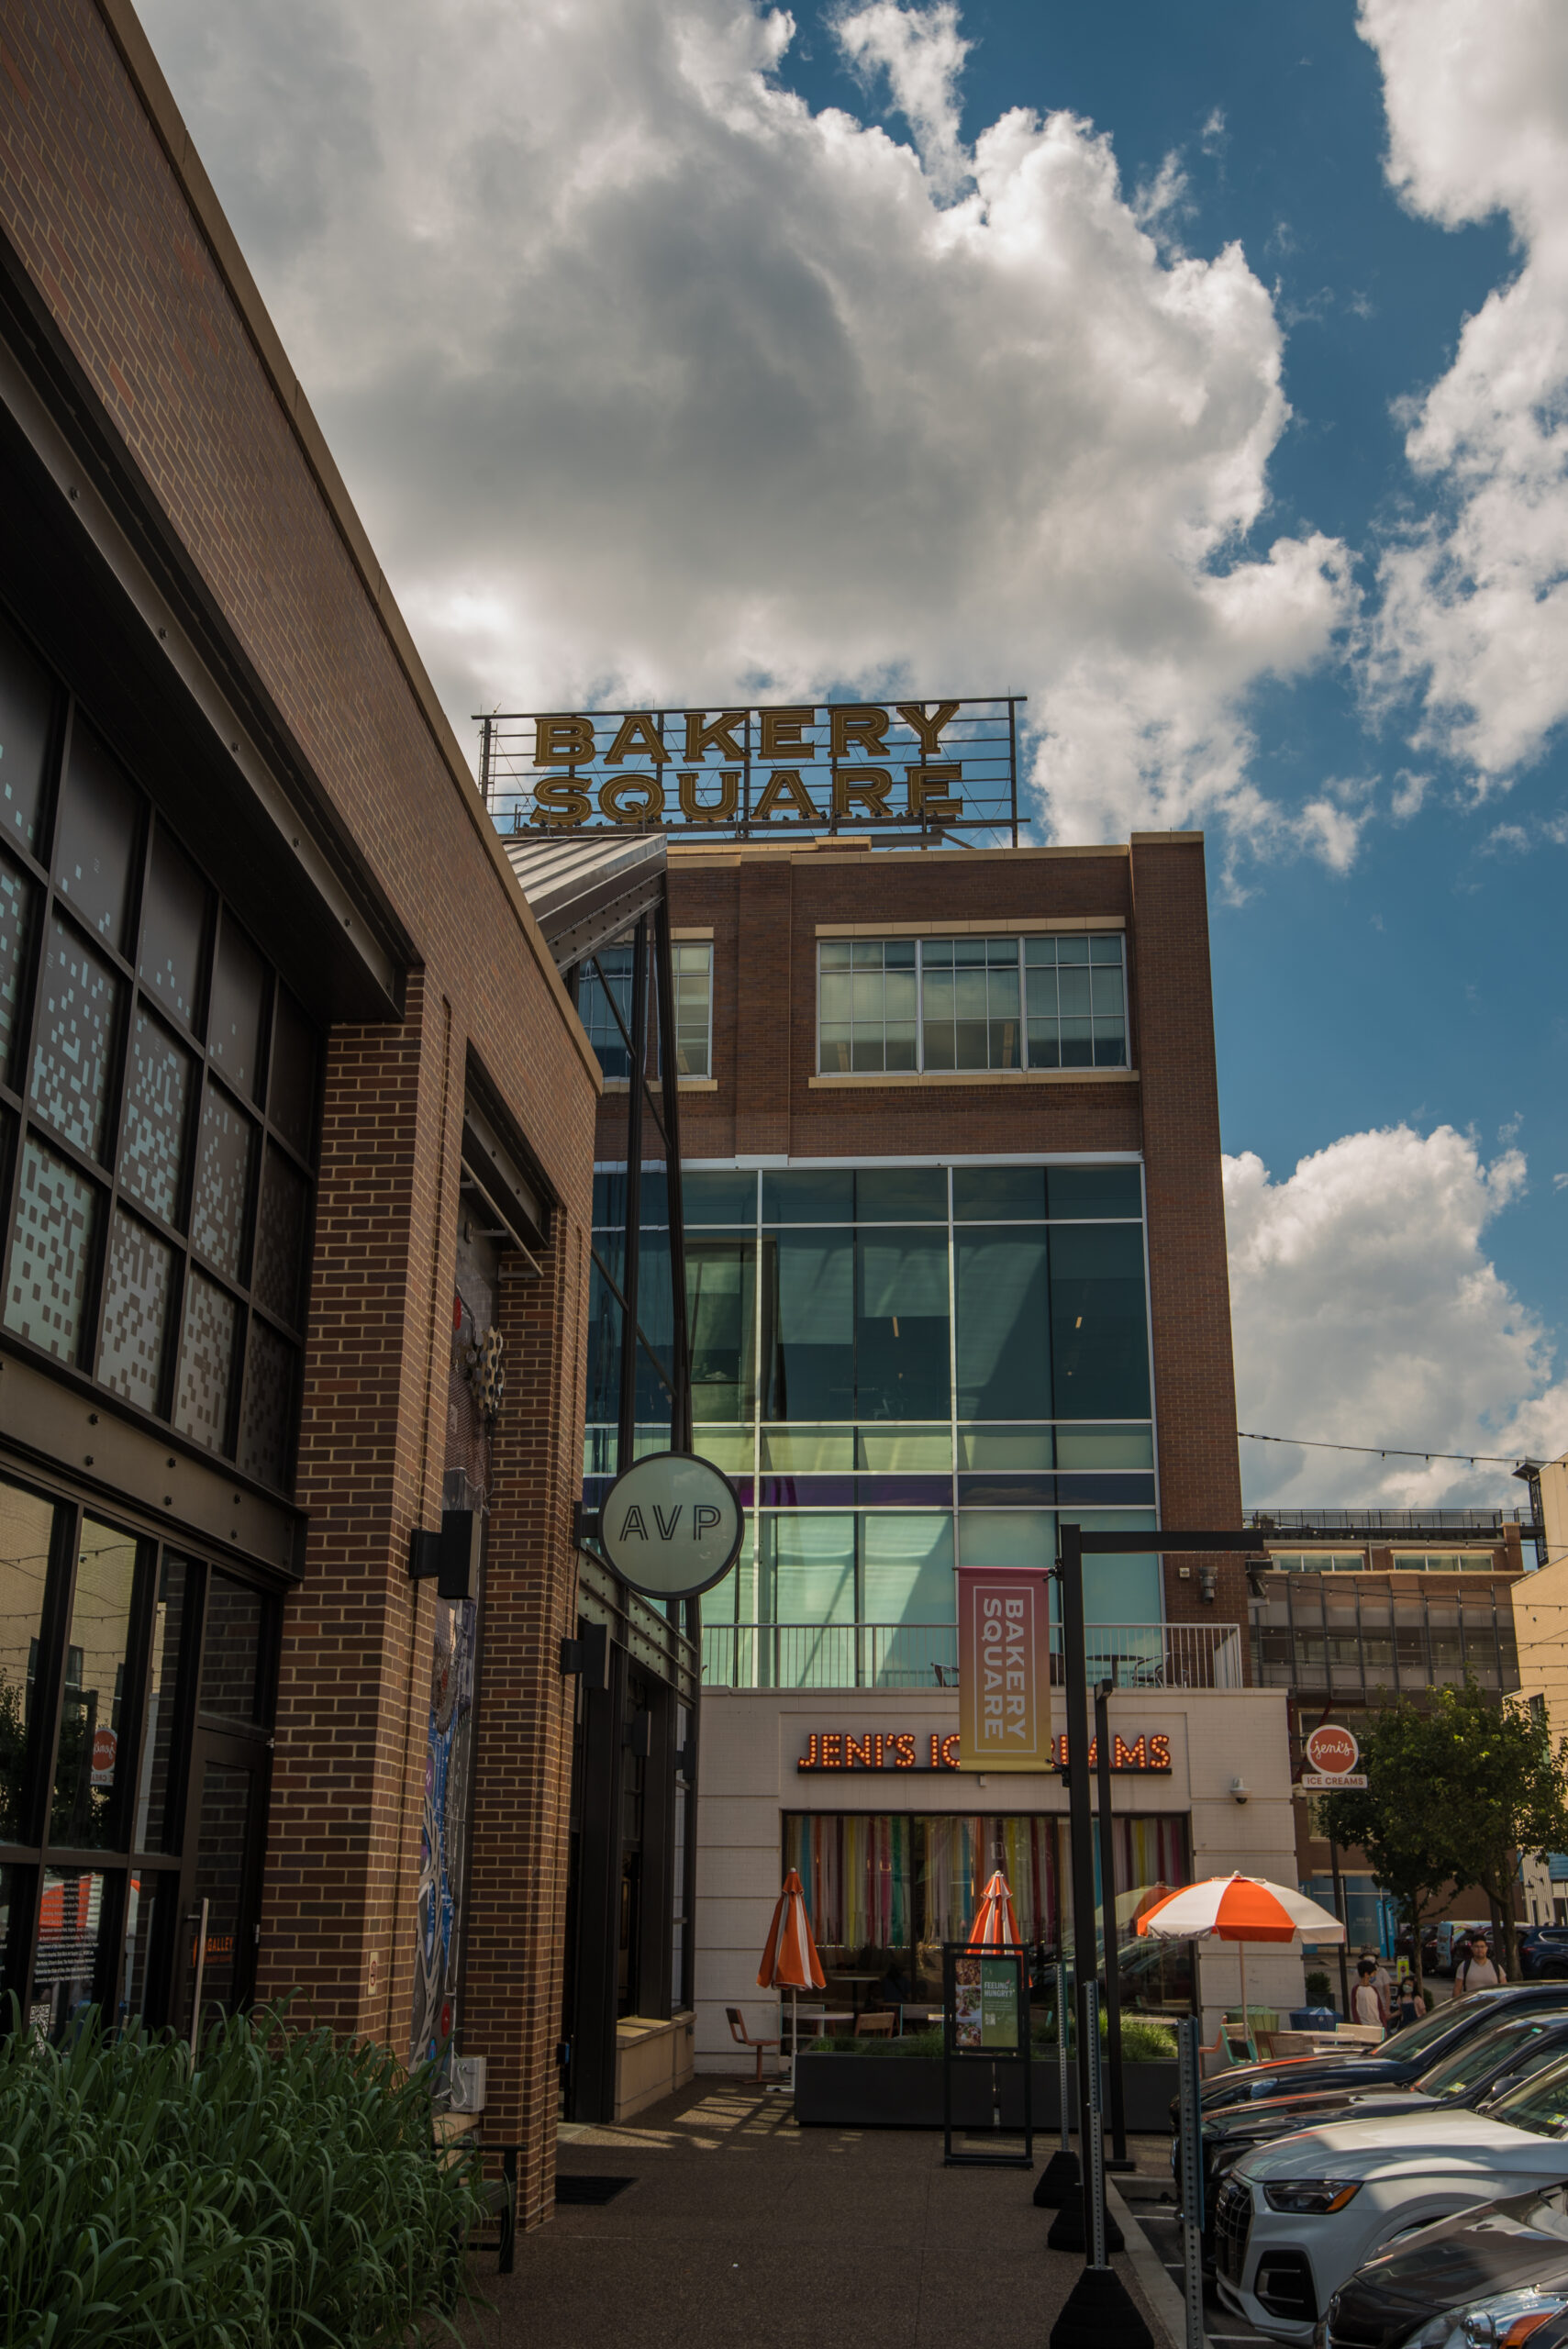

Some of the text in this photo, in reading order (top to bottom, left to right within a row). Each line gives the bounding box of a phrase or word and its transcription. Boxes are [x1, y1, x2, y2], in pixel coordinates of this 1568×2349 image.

[534, 703, 960, 766] BAKERY
[529, 763, 962, 827] SQUARE
[618, 1505, 722, 1542] AVP
[981, 1598, 1004, 1739] SQUARE
[1006, 1599, 1026, 1740] BAKERY
[797, 1733, 916, 1767] JENI'S
[1310, 1741, 1354, 1759] jeni's
